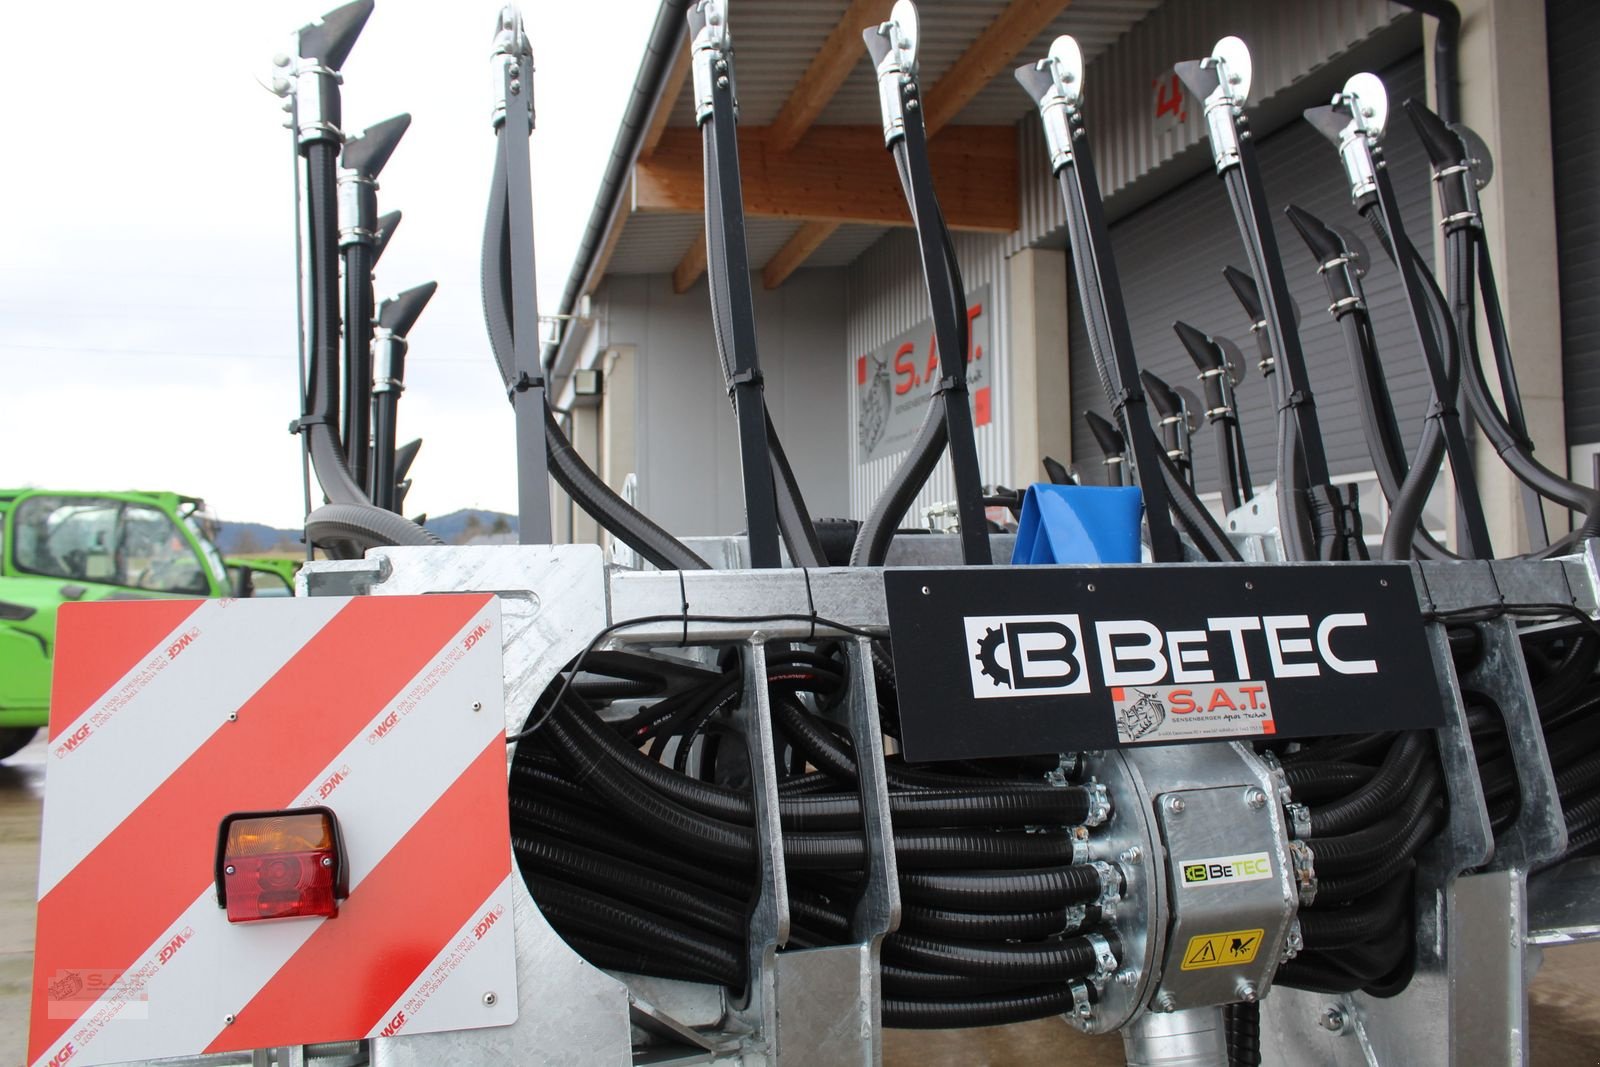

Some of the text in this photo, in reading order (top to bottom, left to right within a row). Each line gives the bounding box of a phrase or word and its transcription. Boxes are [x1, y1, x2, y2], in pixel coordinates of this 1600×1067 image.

[165, 634, 193, 659] WGF
[461, 625, 486, 650] WGF
[1168, 686, 1266, 714] S.A.T.
[63, 723, 92, 750] WGF
[373, 710, 400, 737] WGF
[320, 772, 343, 800] WGF
[471, 912, 498, 939] WGF
[155, 934, 186, 964] WGF
[380, 1011, 406, 1037] WGF
